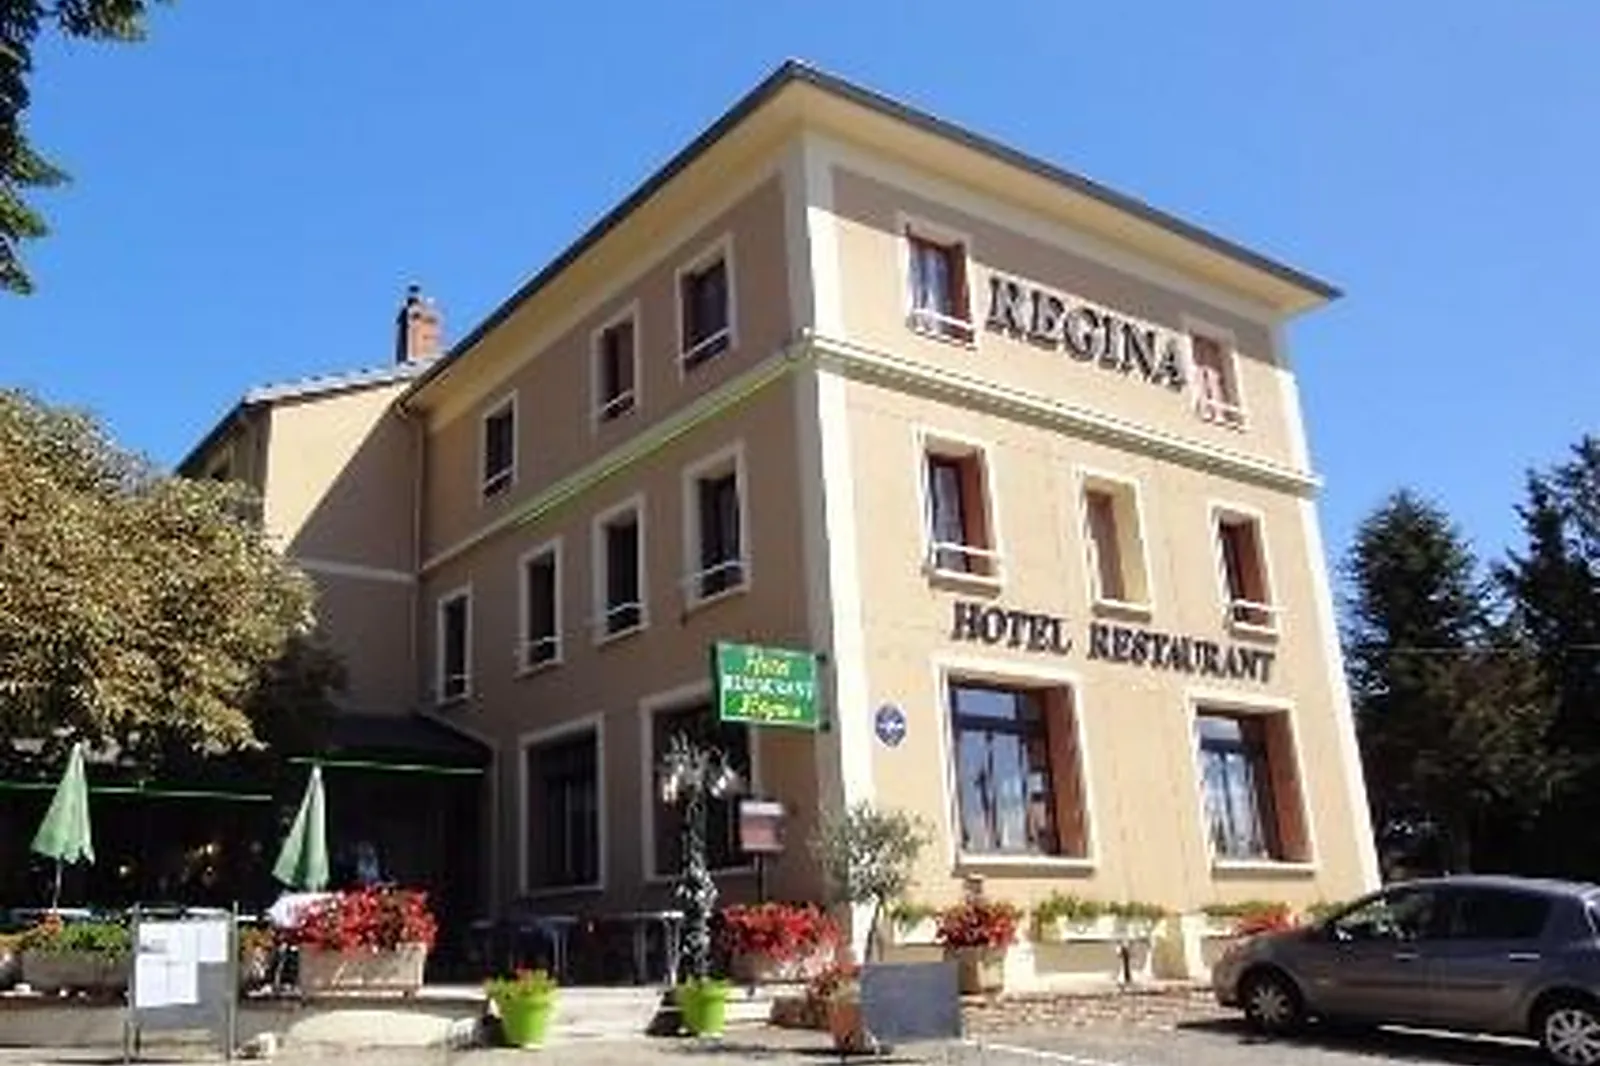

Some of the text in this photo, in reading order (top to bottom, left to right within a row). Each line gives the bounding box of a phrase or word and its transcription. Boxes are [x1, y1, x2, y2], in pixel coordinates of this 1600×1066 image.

[986, 276, 1187, 391] REGINA
[952, 602, 1275, 683] HOTEL RESTAURANT
